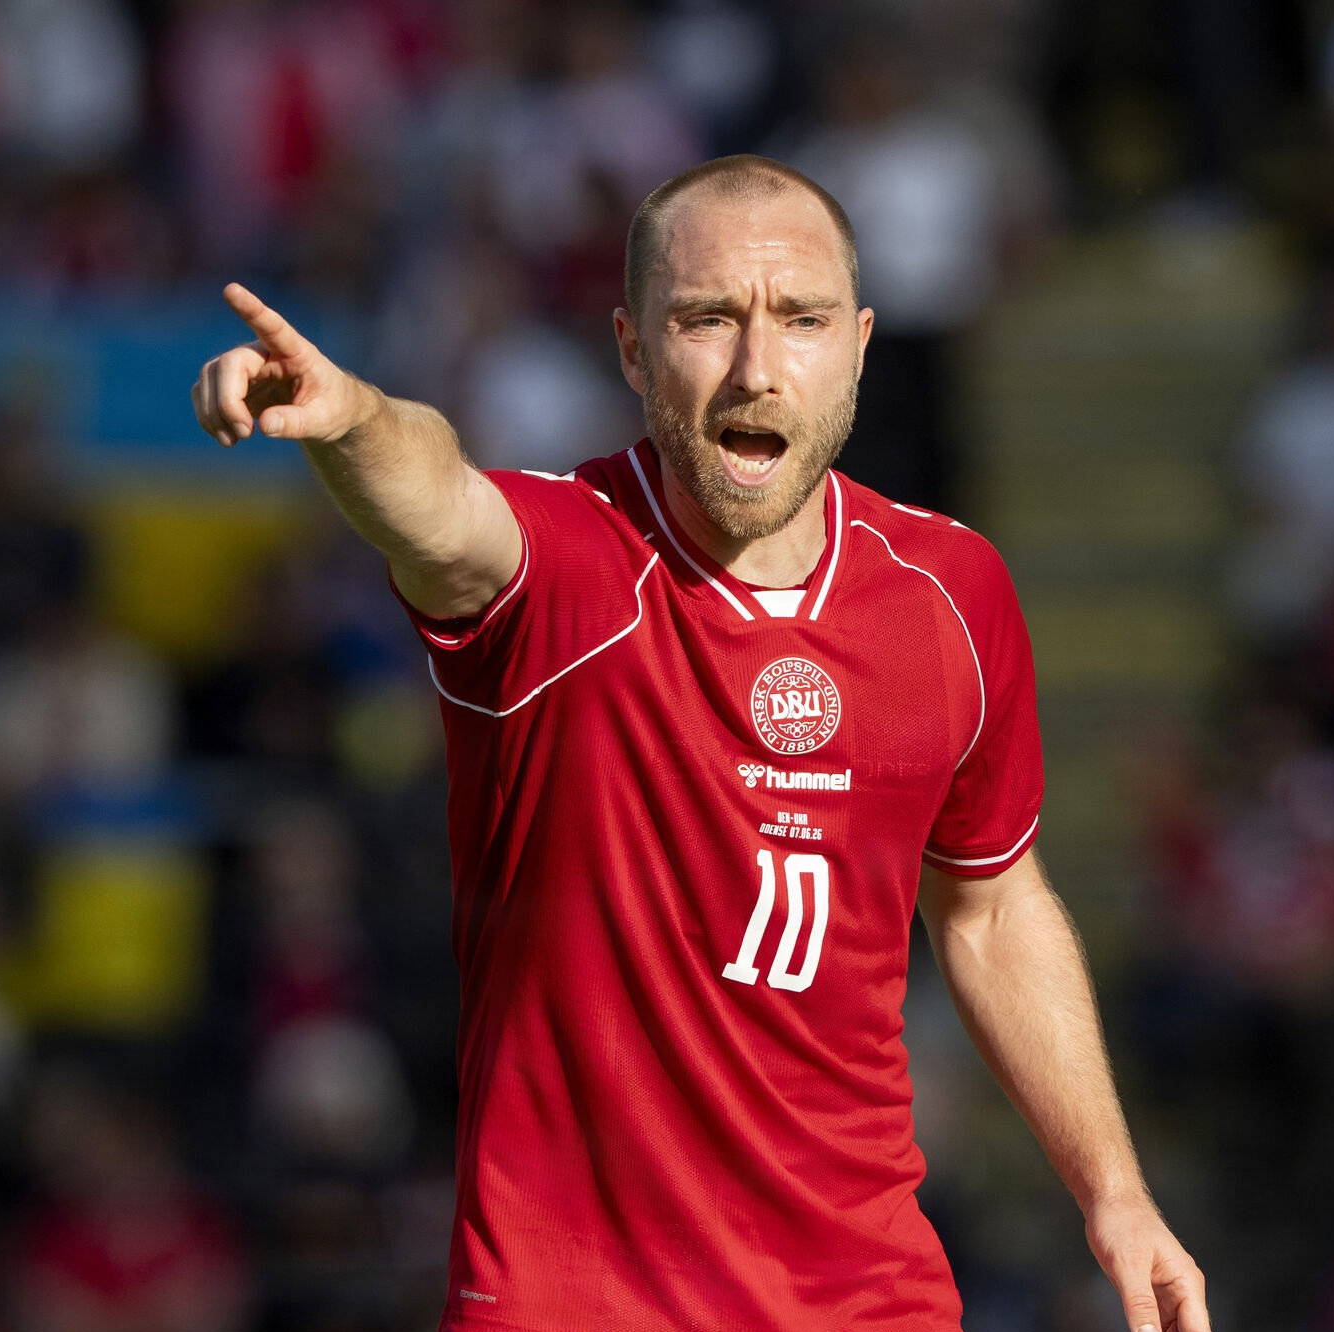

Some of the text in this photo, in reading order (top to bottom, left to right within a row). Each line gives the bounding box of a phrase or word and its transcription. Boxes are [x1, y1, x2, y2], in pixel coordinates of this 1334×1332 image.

[754, 687, 778, 745] DANSK
[770, 690, 823, 720] DBU
[779, 737, 816, 752] 1889
[766, 765, 852, 791] hummel
[759, 822, 823, 841] ODENSE 07.06.26
[721, 848, 830, 993] 10
